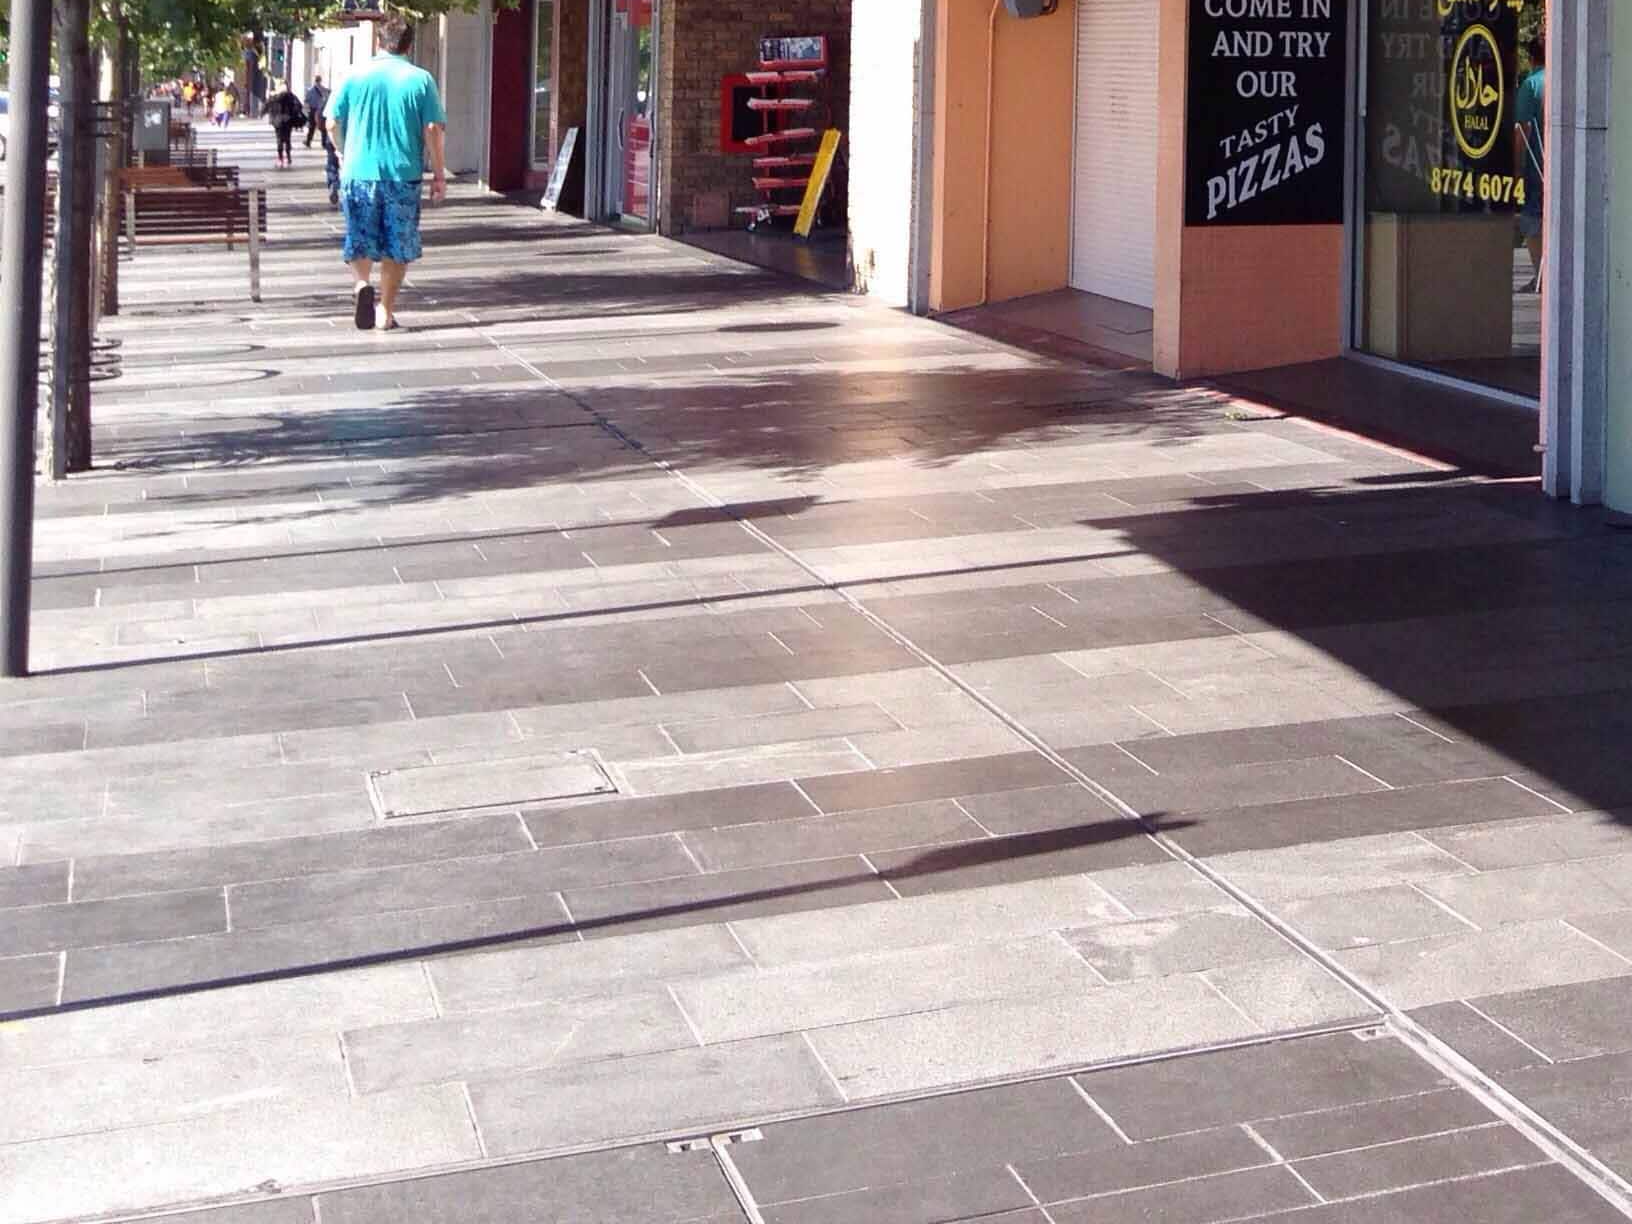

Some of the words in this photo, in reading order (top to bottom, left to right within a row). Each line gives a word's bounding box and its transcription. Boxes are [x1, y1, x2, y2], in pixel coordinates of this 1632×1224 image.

[1211, 31, 1273, 57] AND
[1279, 31, 1332, 58] TRY
[1236, 70, 1298, 98] OUR
[1219, 104, 1300, 159] TASTY
[1464, 114, 1489, 130] HALAL
[1206, 121, 1325, 221] PIZZAS
[1431, 167, 1474, 198] 8774
[1479, 173, 1526, 205] 6074
